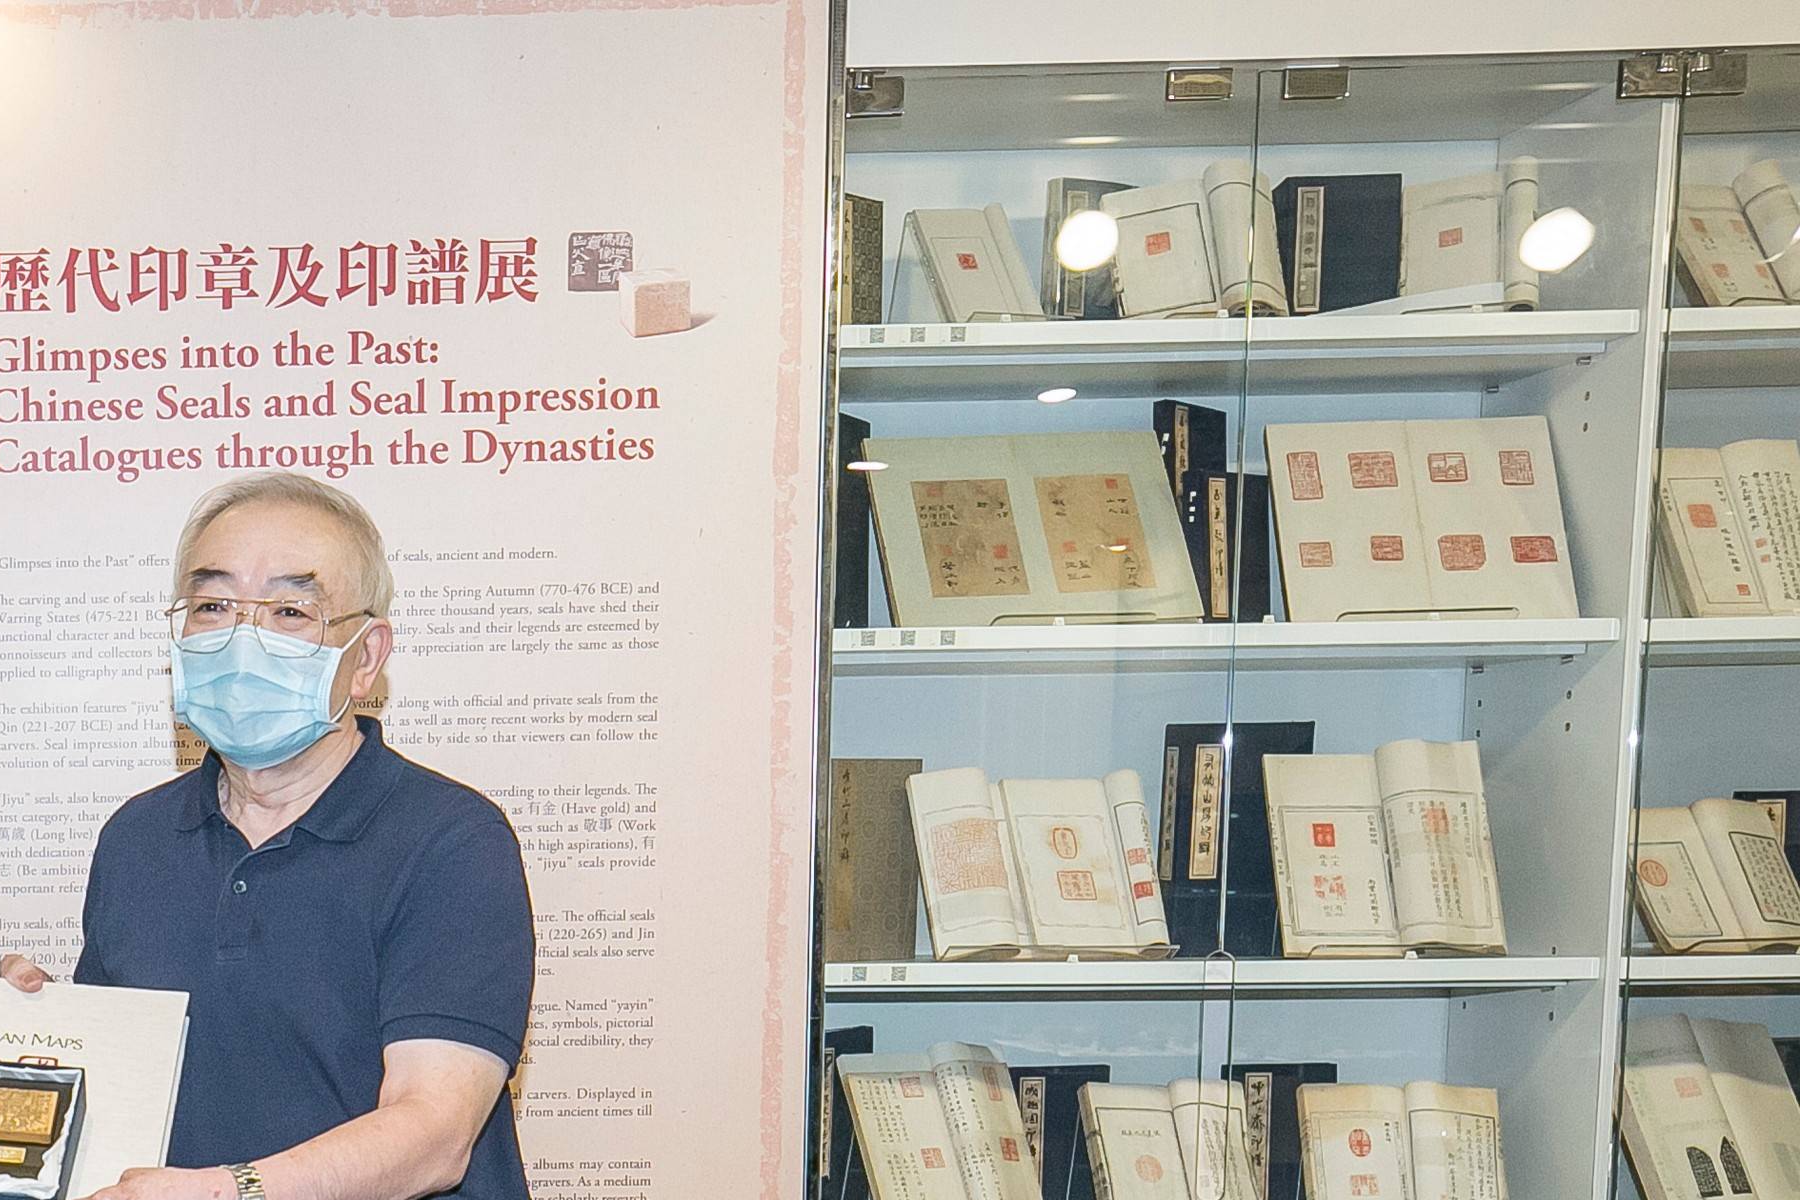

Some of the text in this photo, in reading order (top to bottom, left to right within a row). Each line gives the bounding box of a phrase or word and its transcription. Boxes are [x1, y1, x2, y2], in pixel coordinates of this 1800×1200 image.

[182, 334, 258, 367] into
[275, 331, 334, 366] the
[348, 329, 438, 364] Past:
[156, 383, 250, 419] Seals
[264, 382, 336, 417] and
[350, 380, 425, 415] Seal
[441, 375, 658, 425] Impression
[217, 432, 372, 480] through
[389, 430, 448, 465] the
[462, 426, 653, 475] Dynasties
[56, 557, 79, 567] into
[83, 556, 101, 567] the
[105, 555, 133, 567] Past”
[138, 555, 170, 566] offers
[388, 549, 398, 561] of
[403, 549, 432, 562] seals,
[436, 549, 478, 560] ancient
[482, 548, 504, 559] and
[508, 547, 557, 559] modern.
[18, 594, 60, 608] carving
[64, 592, 86, 604] and
[113, 592, 127, 603] of
[129, 591, 154, 603] seals
[404, 588, 415, 597] to
[420, 586, 438, 597] the
[442, 585, 481, 601] Spring
[486, 584, 534, 596] Autumn
[540, 583, 595, 597] (770-476
[600, 582, 633, 596] BCE)
[638, 582, 659, 593] and
[56, 629, 108, 640] character
[113, 628, 134, 640] and
[426, 622, 454, 633] Seals
[459, 622, 480, 633] and
[485, 621, 512, 633] their
[518, 620, 560, 636] legends
[586, 619, 640, 631] esteemed
[644, 619, 659, 634] by
[22, 719, 75, 733] (221-207
[80, 719, 112, 733] BCE)
[117, 719, 138, 730] and
[143, 718, 168, 730] Han
[414, 713, 437, 725] well
[457, 716, 486, 724] more
[491, 714, 525, 724] recent
[530, 711, 564, 723] works
[569, 711, 583, 726] by
[587, 710, 632, 722] modern
[637, 710, 657, 721] seal
[561, 802, 596, 816] (Have
[600, 801, 630, 817] gold)
[634, 801, 656, 812] and
[30, 828, 64, 843] (Long
[69, 827, 95, 841] live).
[537, 820, 563, 831] such
[618, 819, 656, 833] (Work
[548, 927, 654, 941] (220-265) and Jin
[566, 998, 652, 1013] Named “yayin”
[528, 1034, 653, 1049] social credibility, they
[526, 1104, 652, 1116] from ancient times till
